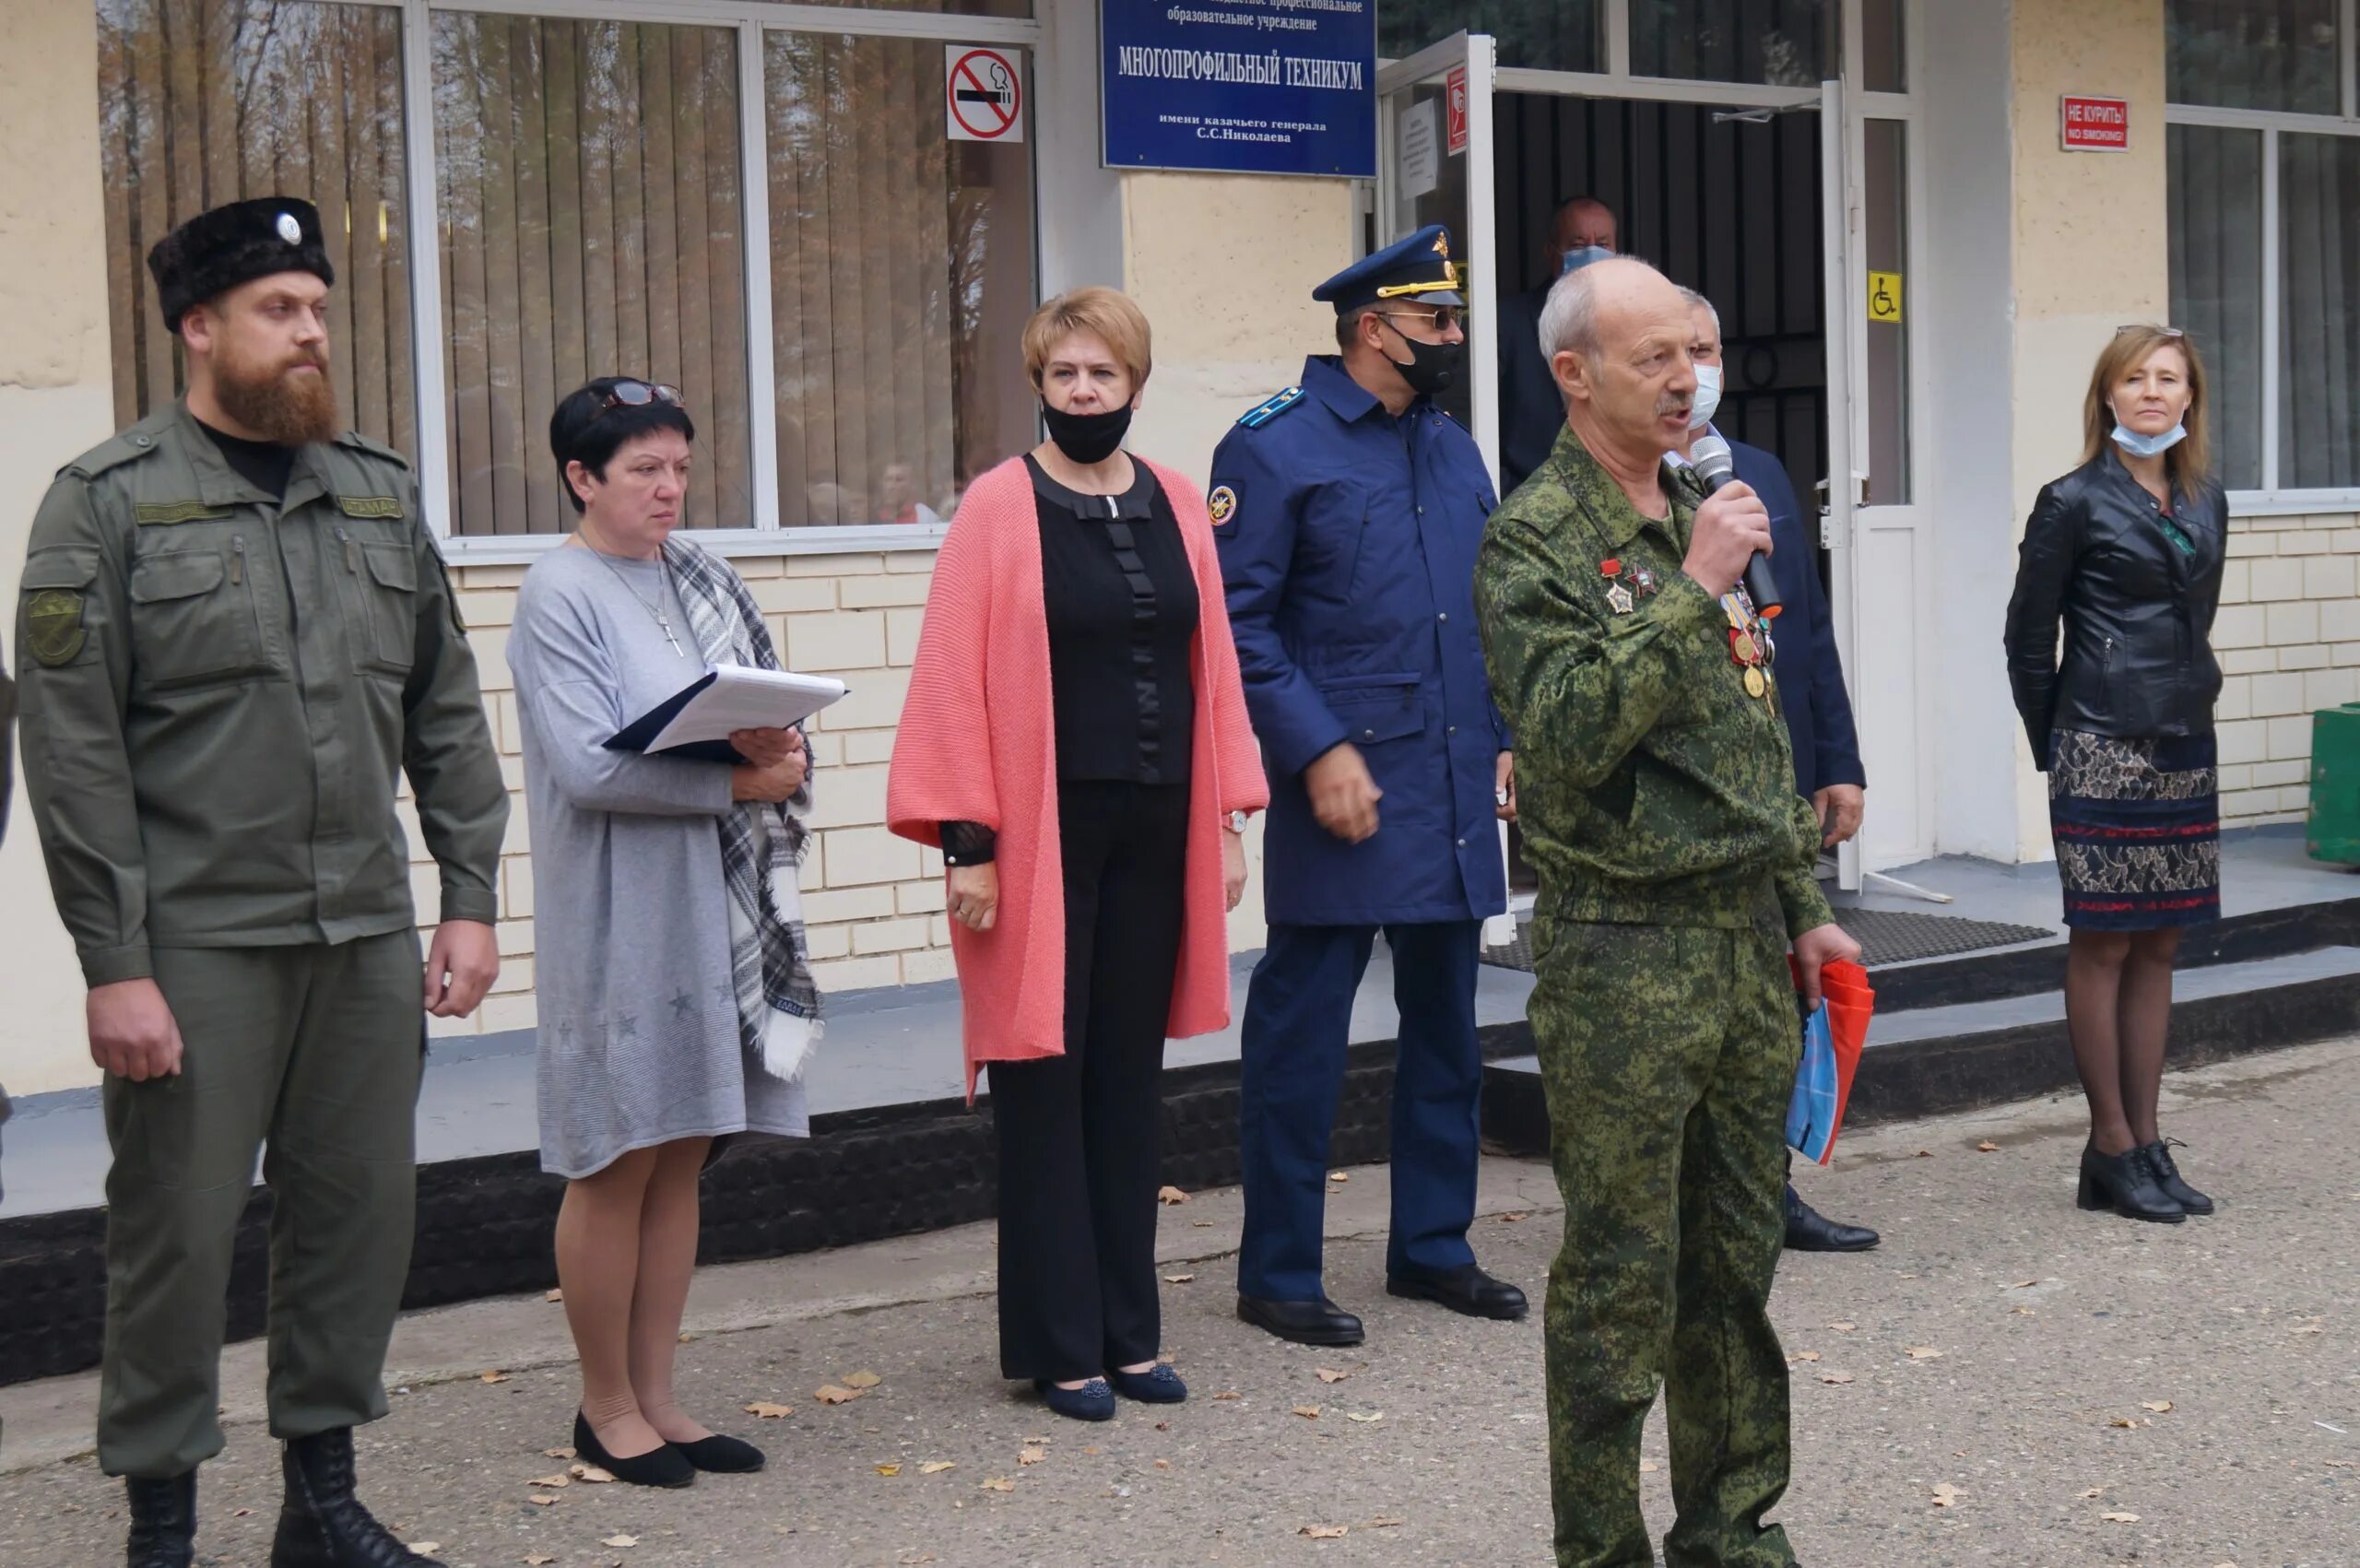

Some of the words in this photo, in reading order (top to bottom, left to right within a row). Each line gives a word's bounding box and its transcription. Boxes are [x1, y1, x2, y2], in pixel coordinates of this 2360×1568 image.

[1167, 6, 1255, 26] образовательное
[1257, 14, 1317, 31] учреждение
[1118, 45, 1280, 85] МНОГОПРОФИЛЬНЫЙ
[1284, 56, 1363, 90] ТЕХНИКУМ
[1159, 113, 1200, 124] имени
[1204, 116, 1268, 128] казачьего
[1271, 121, 1327, 132] генерала
[2068, 104, 2082, 122] НЕ
[2084, 105, 2124, 124] КУРИТЬ!
[1197, 126, 1292, 143] С.С.Николаева
[2069, 128, 2081, 139] NO
